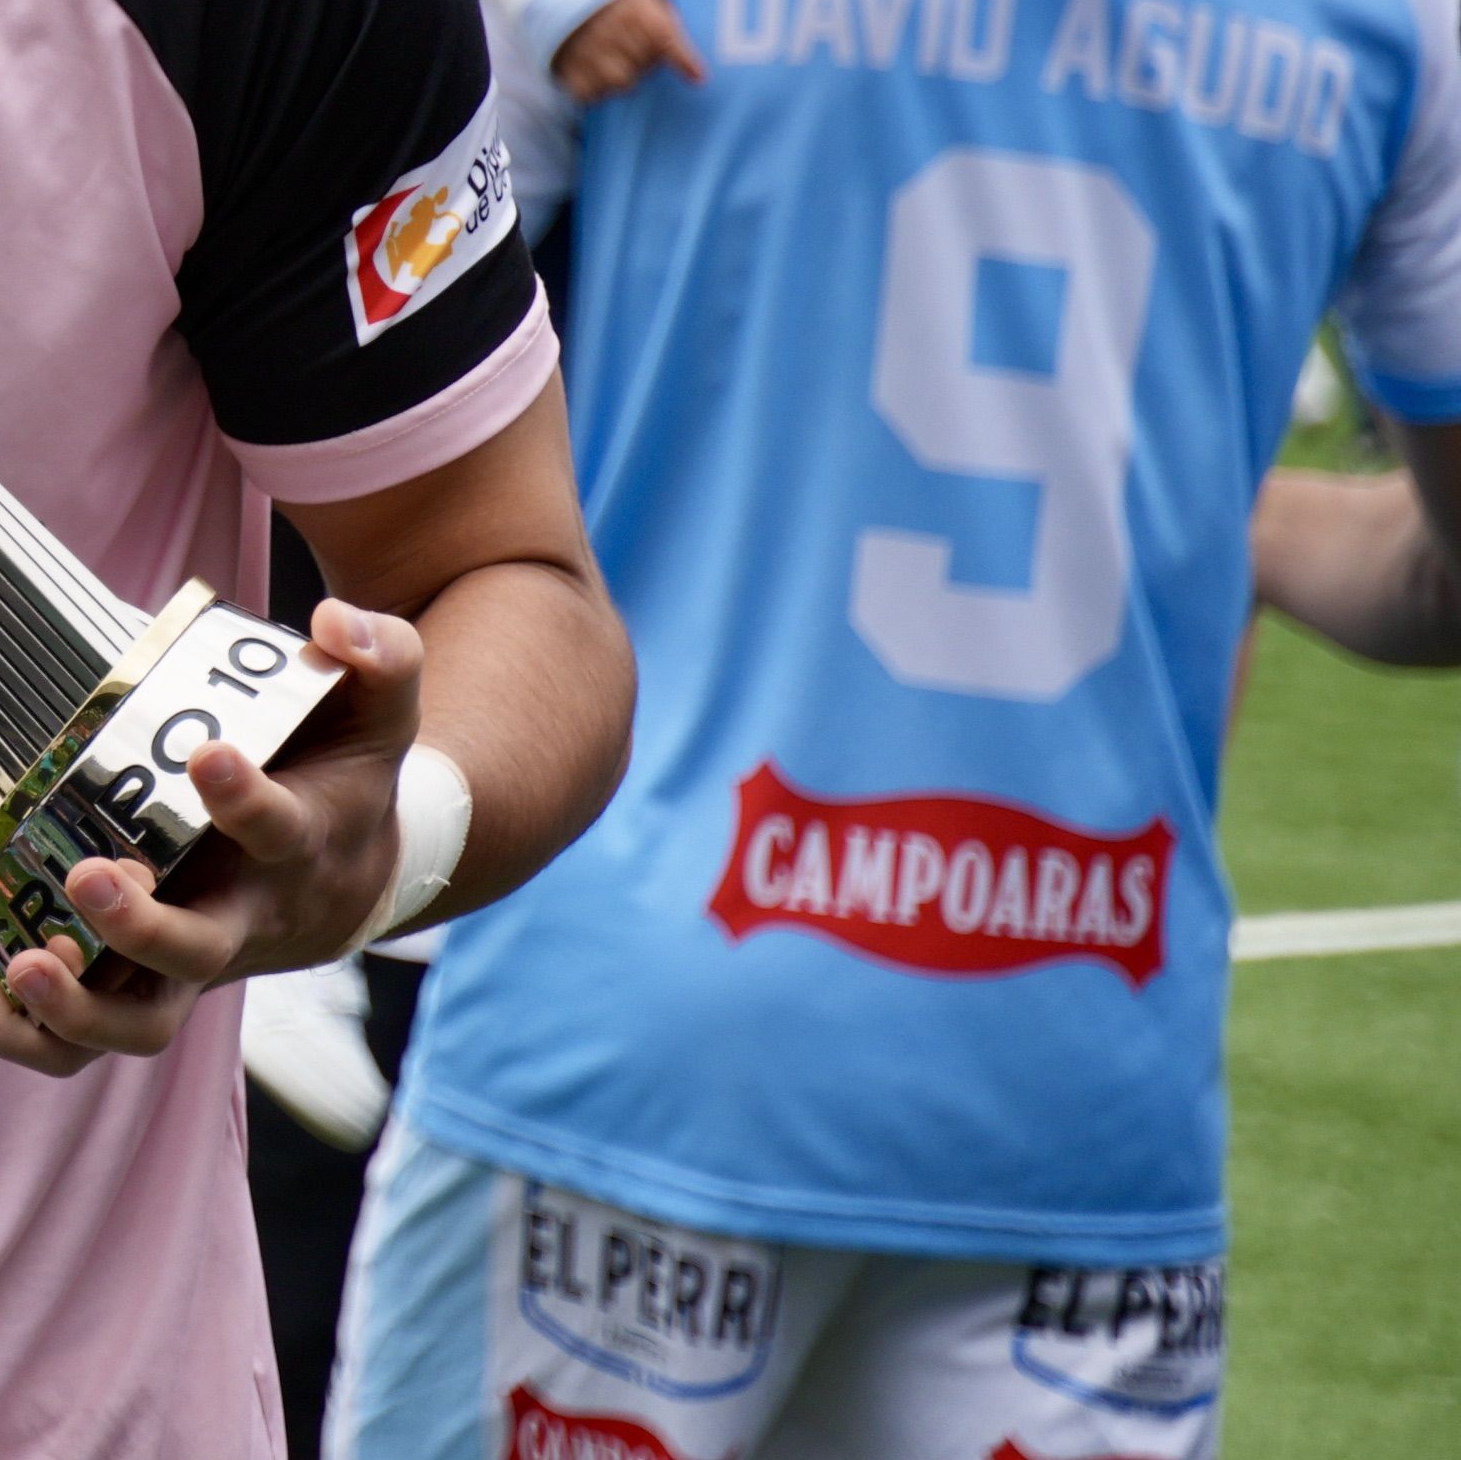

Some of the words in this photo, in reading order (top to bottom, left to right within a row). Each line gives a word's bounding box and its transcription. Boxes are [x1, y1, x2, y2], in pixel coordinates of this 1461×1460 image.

[848, 147, 1158, 706] 9
[206, 636, 289, 700] 10
[742, 812, 1157, 948] CAMPOARAS
